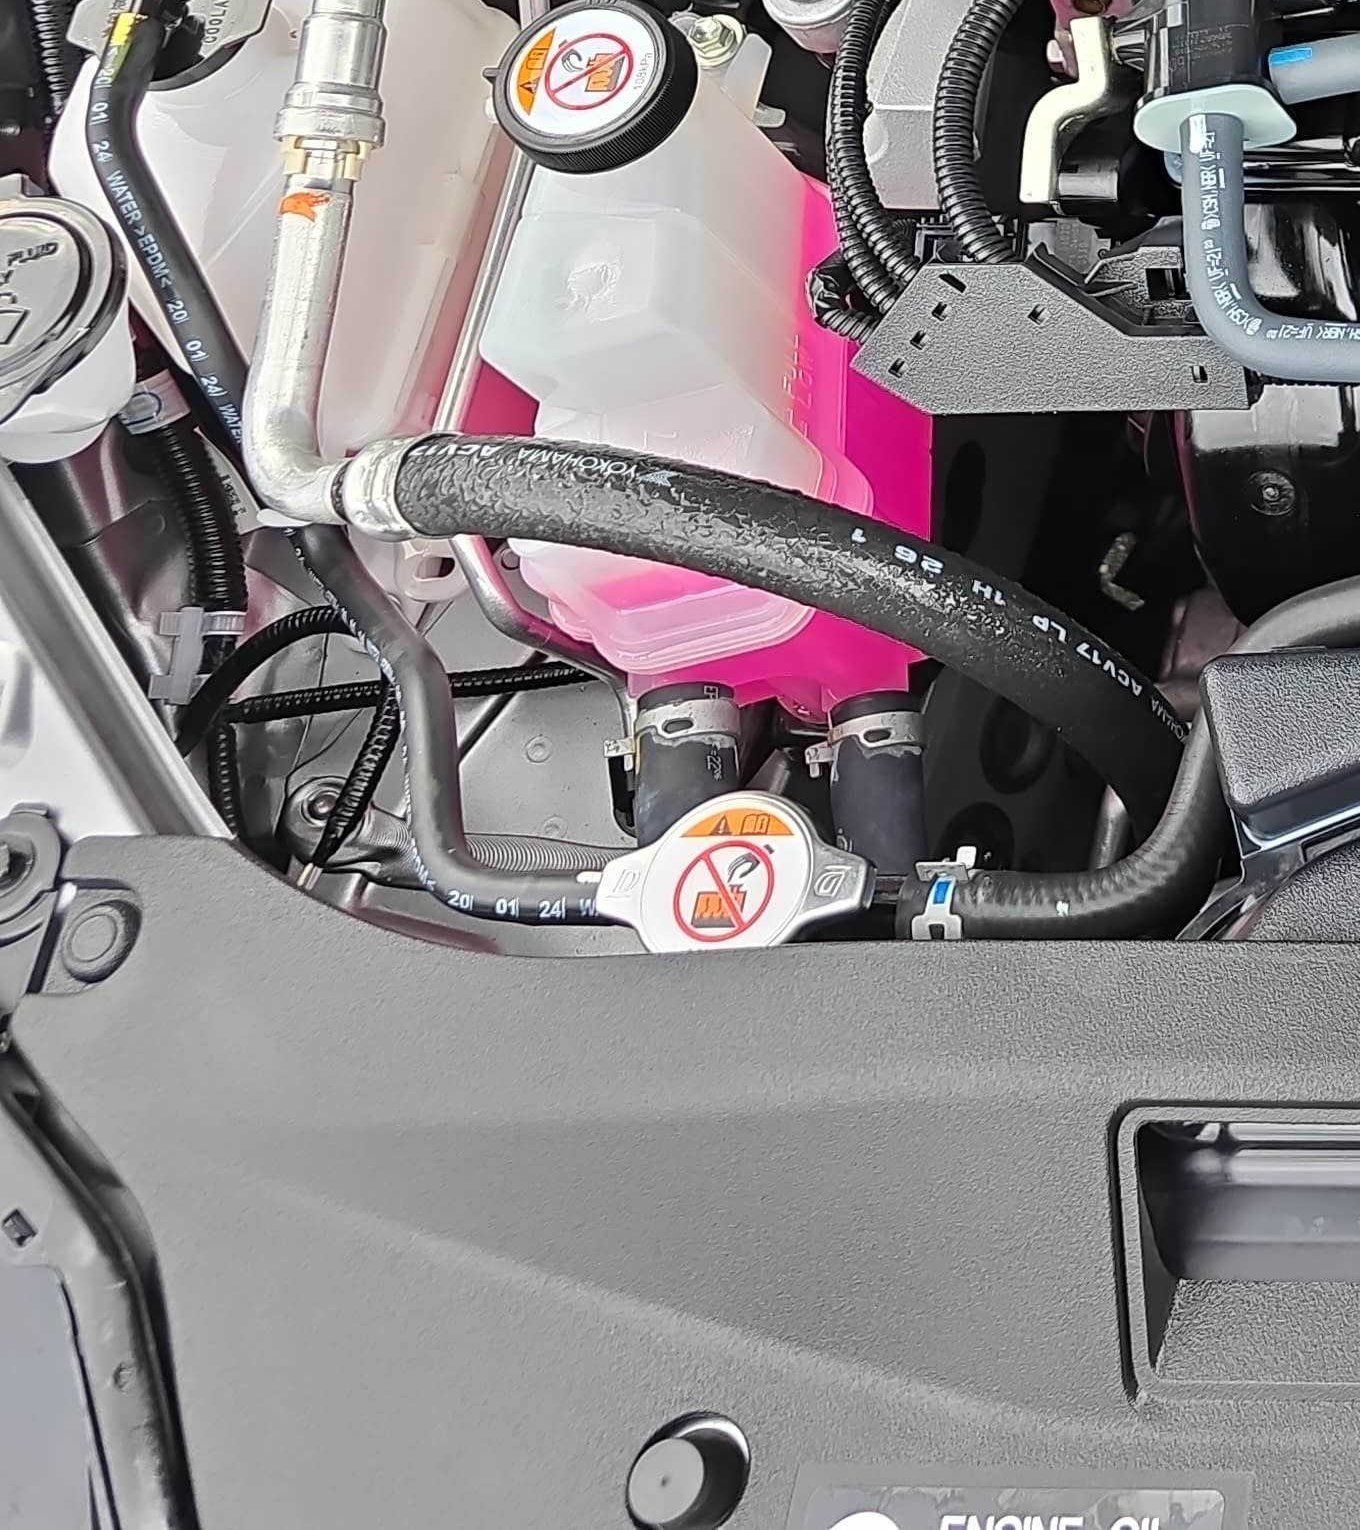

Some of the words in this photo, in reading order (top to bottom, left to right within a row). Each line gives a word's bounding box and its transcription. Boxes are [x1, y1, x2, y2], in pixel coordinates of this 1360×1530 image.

[517, 449, 638, 476] YOKOHAMA
[1031, 614, 1067, 646] LP
[1075, 642, 1142, 696] ACV17
